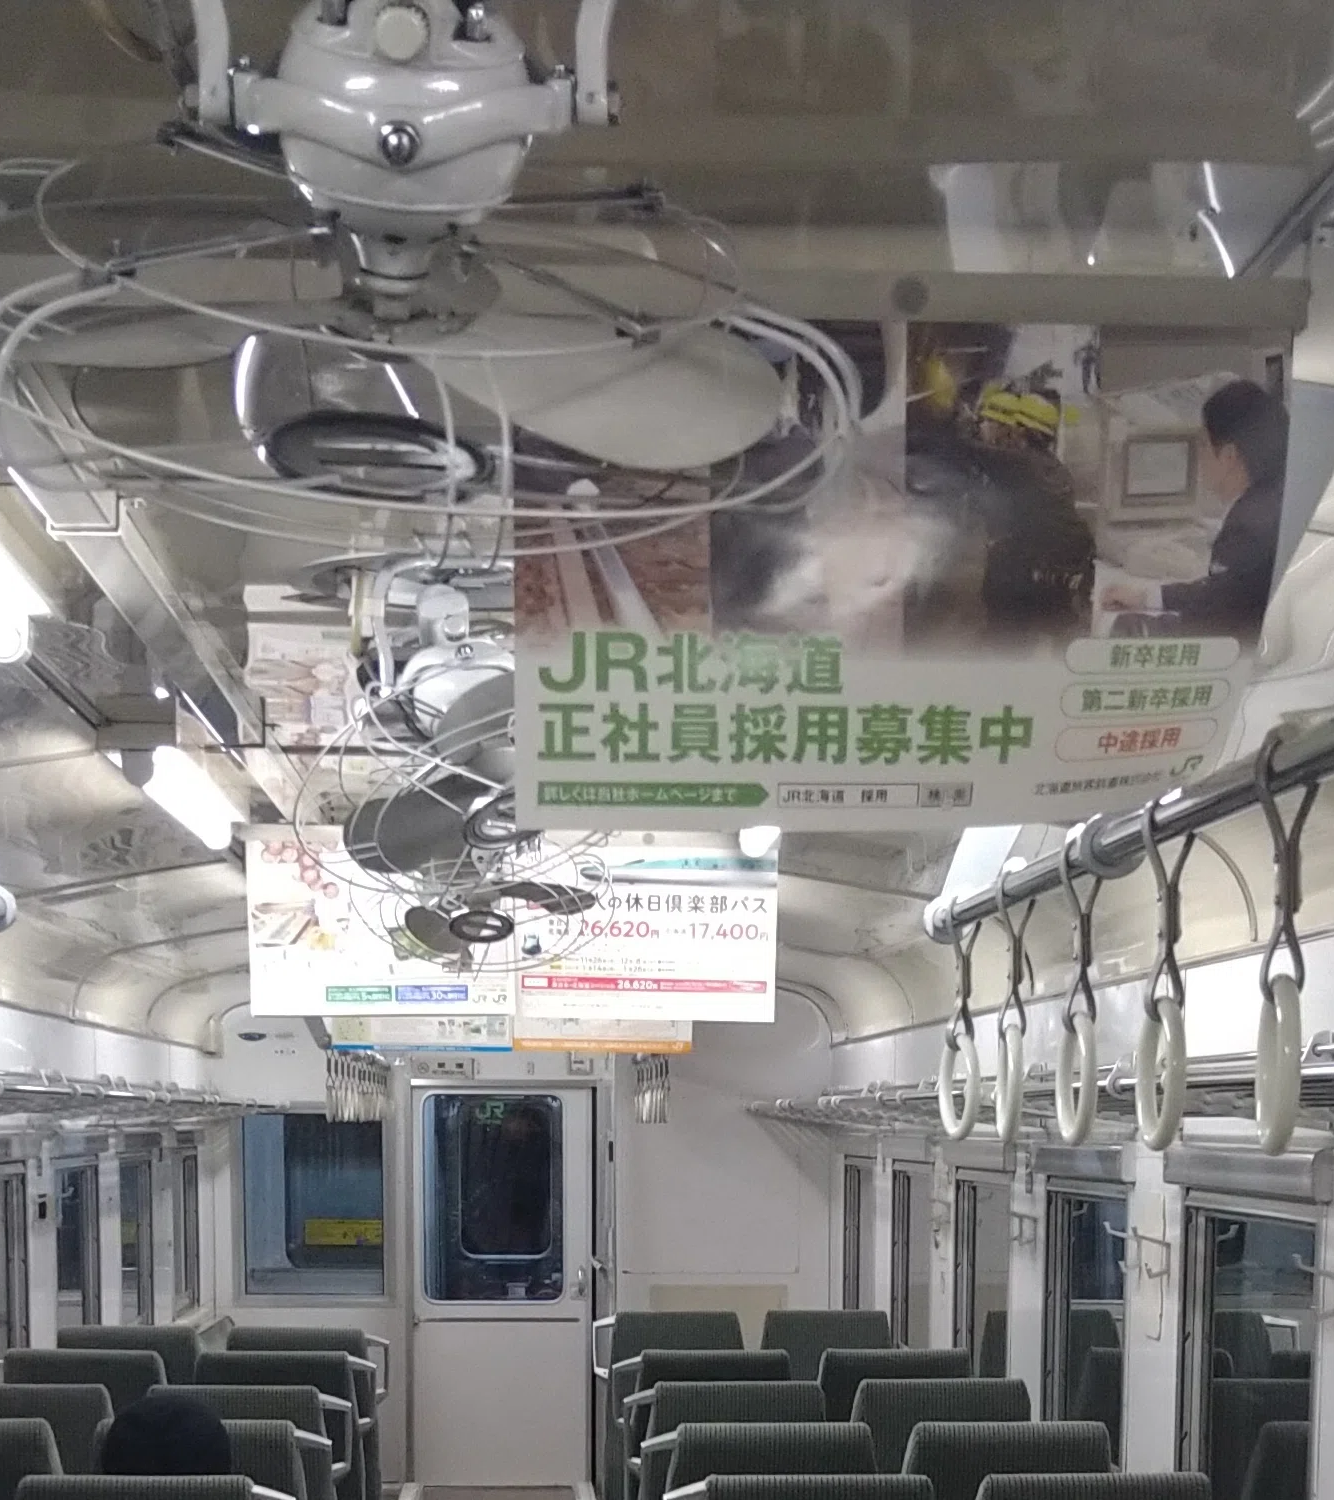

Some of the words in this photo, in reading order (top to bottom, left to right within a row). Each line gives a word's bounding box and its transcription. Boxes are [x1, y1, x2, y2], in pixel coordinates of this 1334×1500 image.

[538, 630, 844, 695] JR北海道
[1109, 643, 1201, 669] 新卒採用
[1080, 684, 1213, 713] 第二新卒採用
[537, 701, 1034, 766] 正社員採用募集中
[1097, 726, 1182, 754] 中途採用
